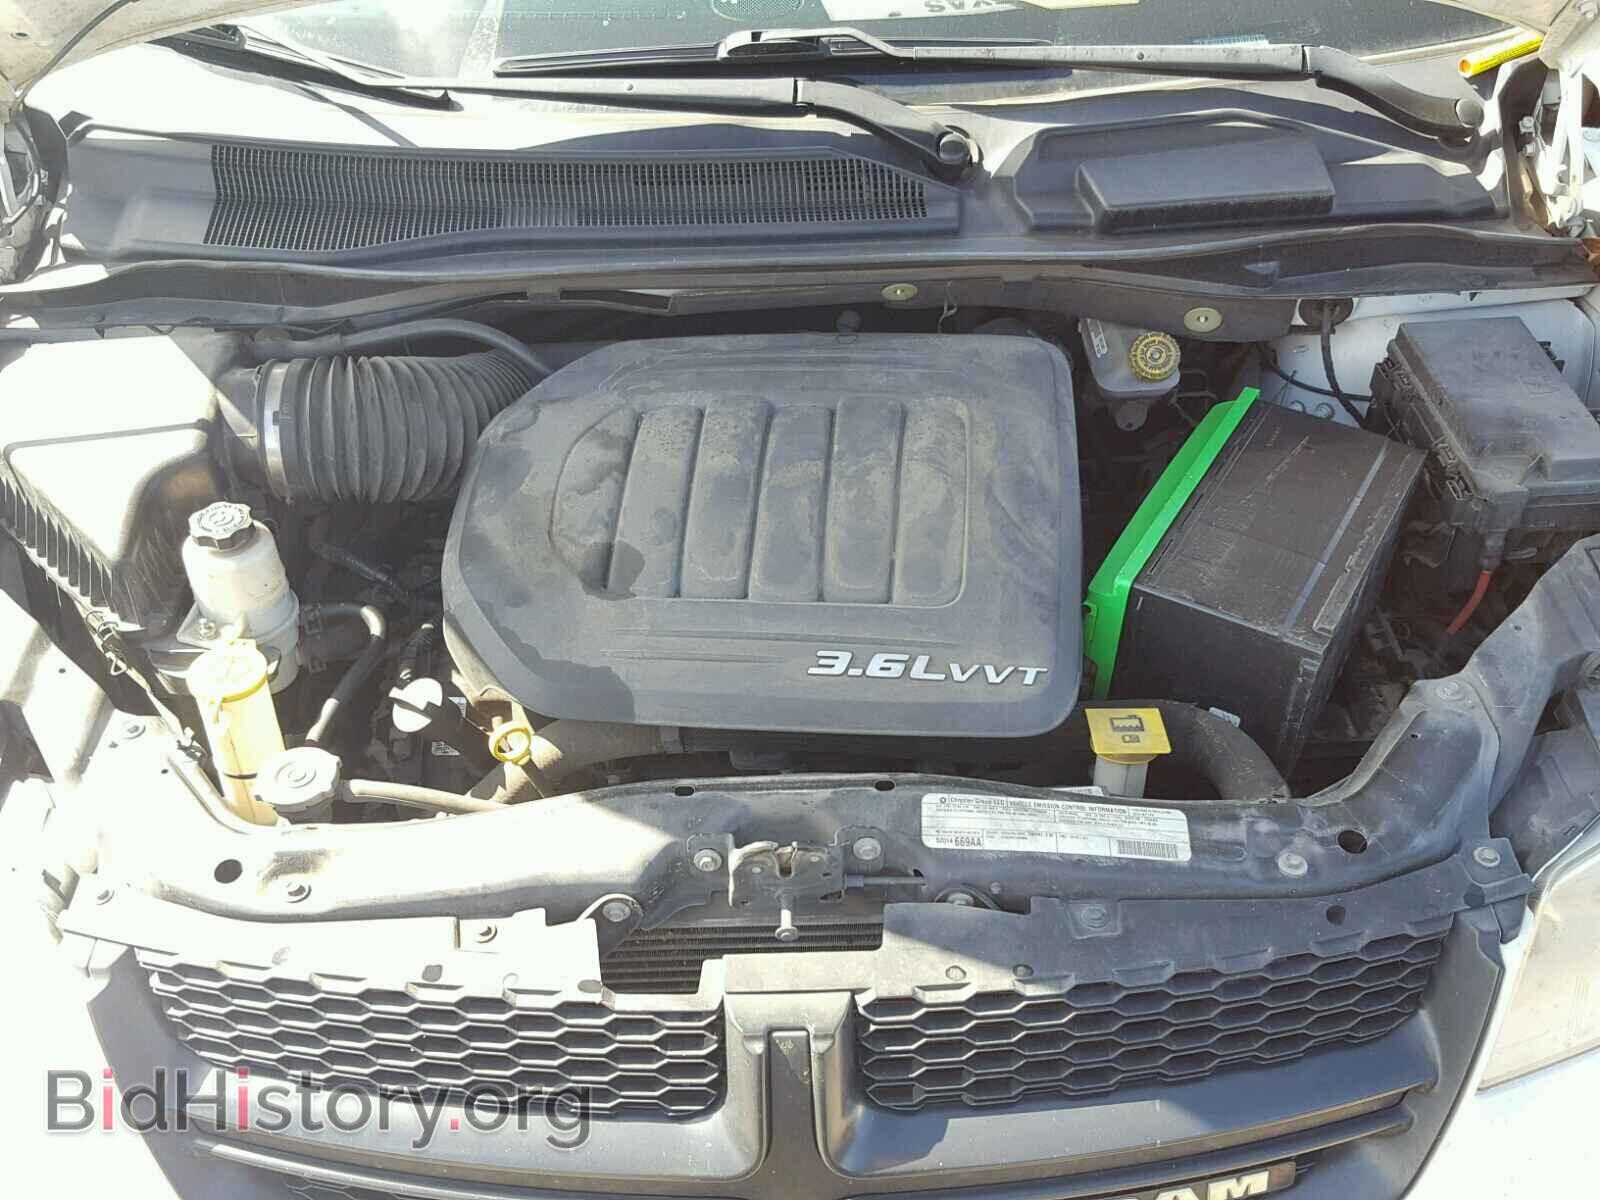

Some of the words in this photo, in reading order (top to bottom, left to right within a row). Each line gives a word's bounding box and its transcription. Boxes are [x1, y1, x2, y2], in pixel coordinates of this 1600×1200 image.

[1034, 801, 1060, 809] EMISSION
[1088, 806, 1127, 814] INFORMATION
[954, 836, 982, 848] 669AA
[1103, 1170, 1270, 1200] AM
